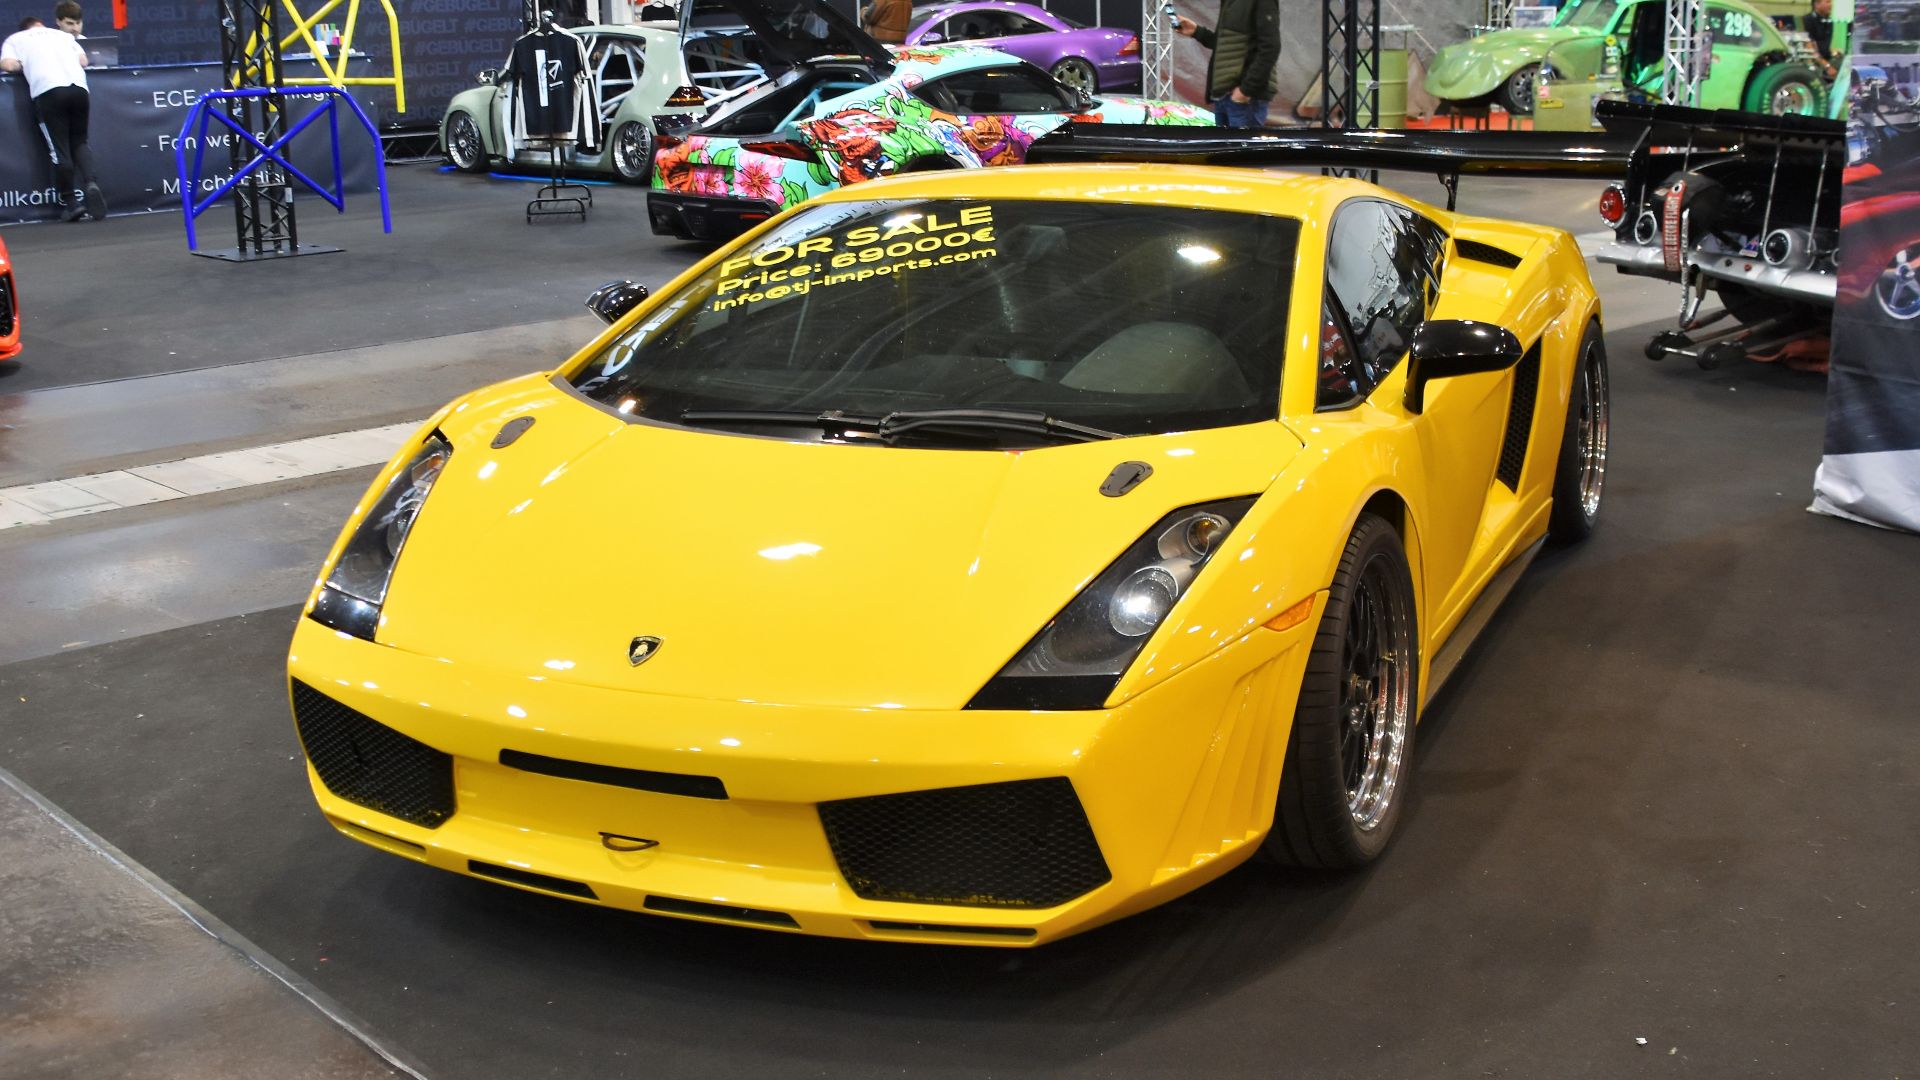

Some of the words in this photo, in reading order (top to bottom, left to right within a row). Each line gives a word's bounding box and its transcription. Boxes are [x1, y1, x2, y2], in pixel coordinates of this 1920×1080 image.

[1724, 11, 1752, 38] 298
[1664, 196, 1681, 219] FLIGHT
[717, 262, 822, 295] Price:
[831, 226, 996, 268] 69000€
[719, 237, 833, 278] FOR
[843, 205, 994, 247] SALE
[713, 247, 998, 313] info@tj-imports.com
